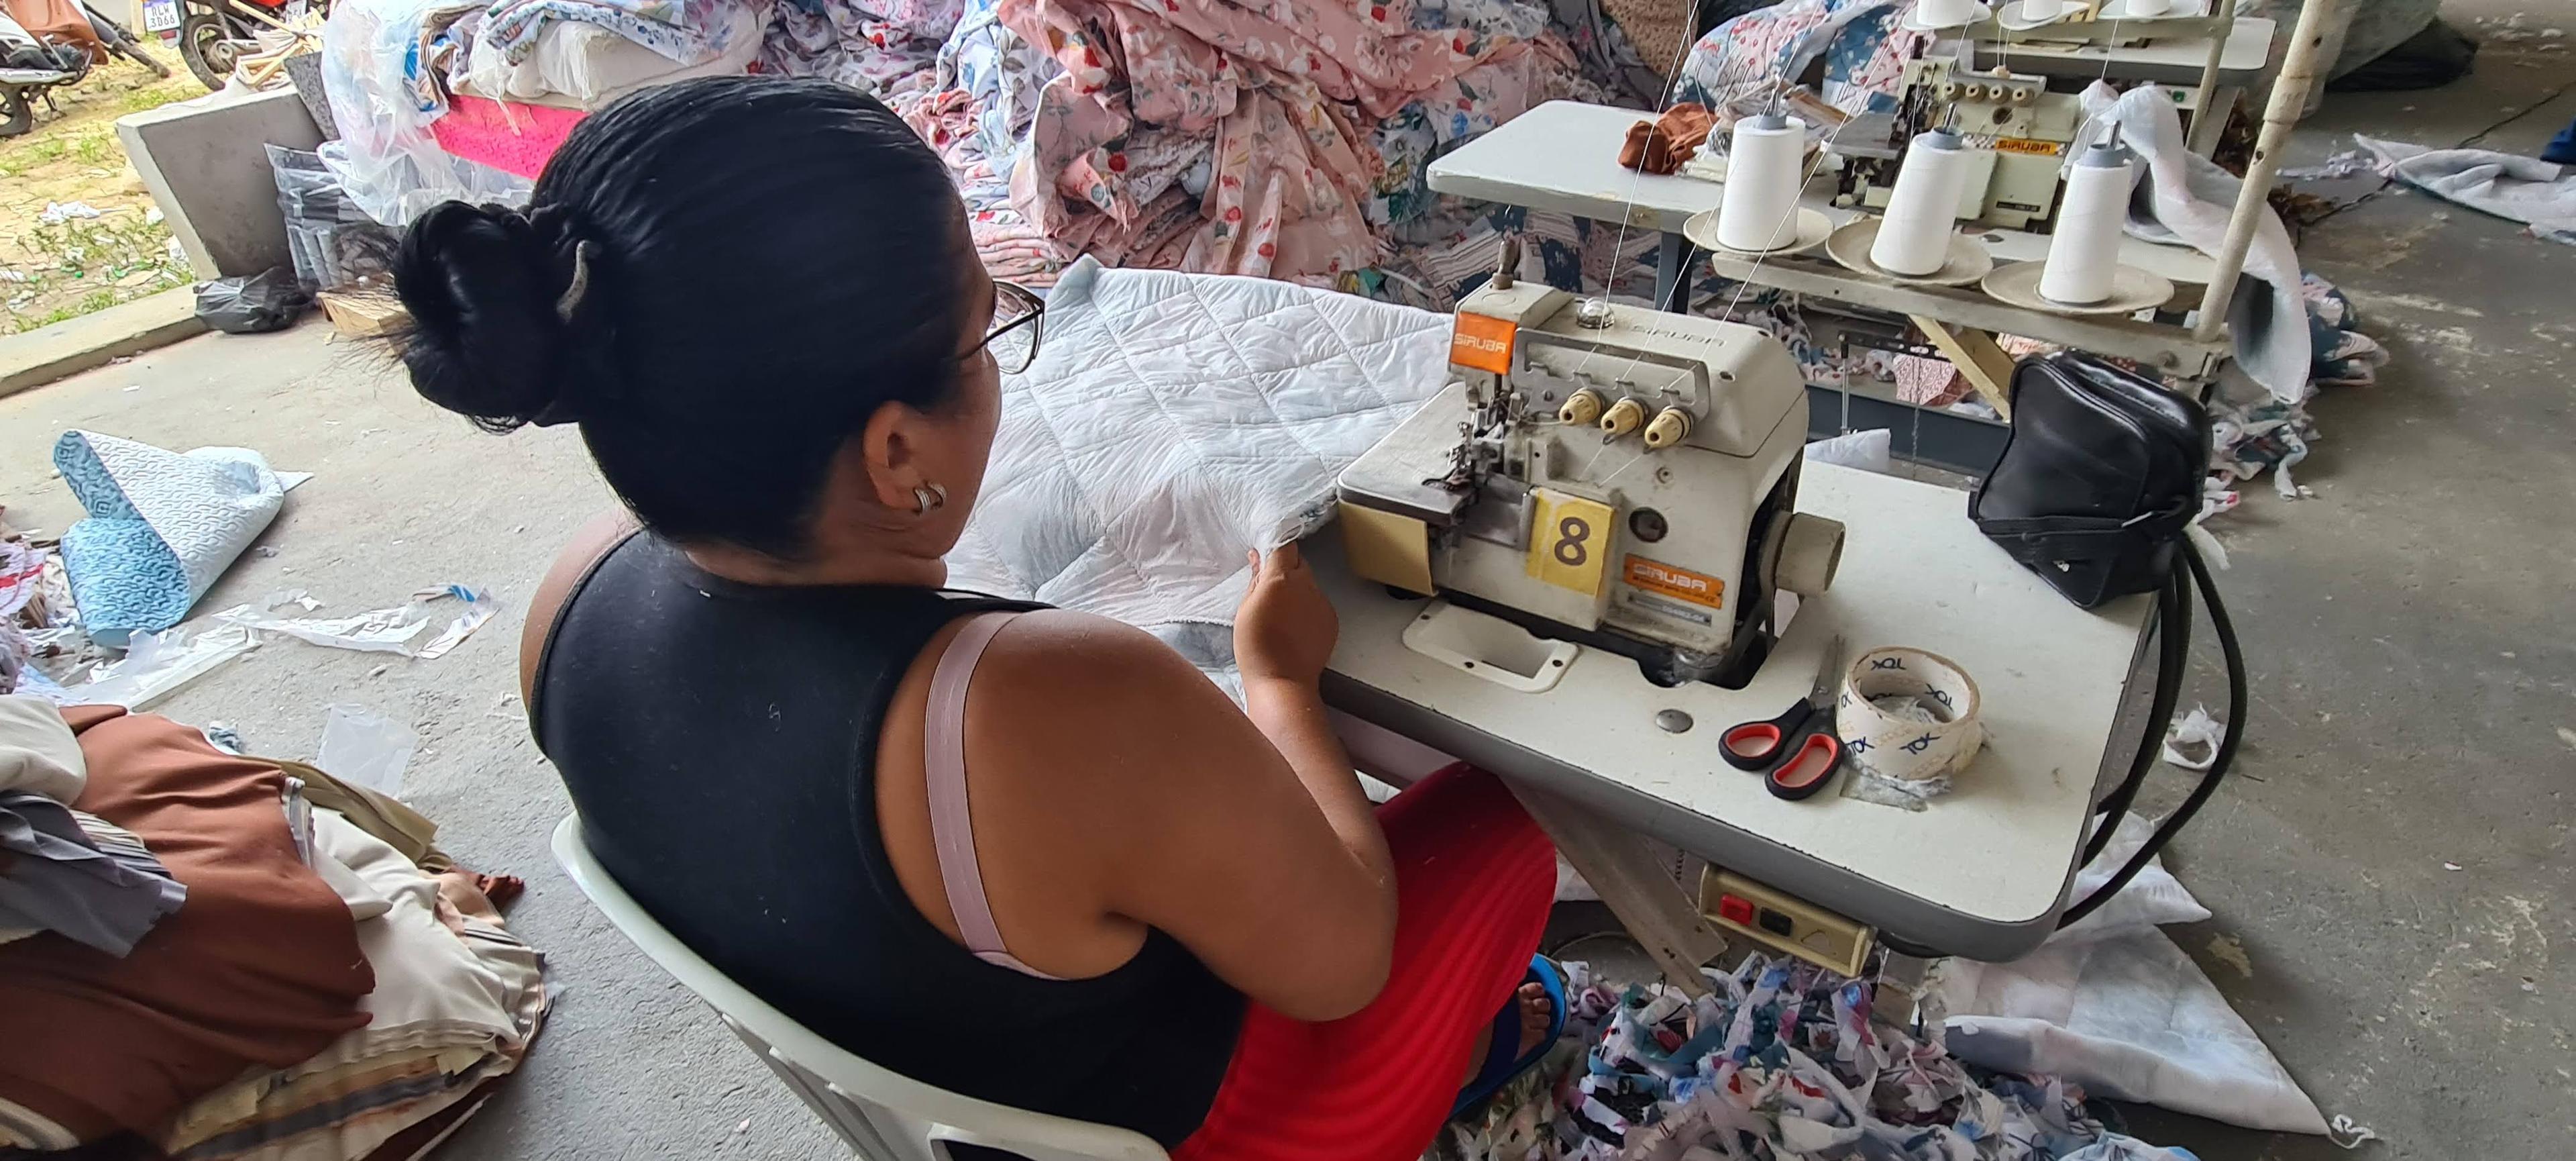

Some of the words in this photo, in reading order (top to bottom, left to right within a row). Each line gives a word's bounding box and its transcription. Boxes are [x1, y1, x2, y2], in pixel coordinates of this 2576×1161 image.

[150, 14, 176, 28] 3D66
[1453, 333, 1507, 354] SIRUBA
[1554, 517, 1591, 566] 8
[1633, 562, 1707, 592] SIRUBA
